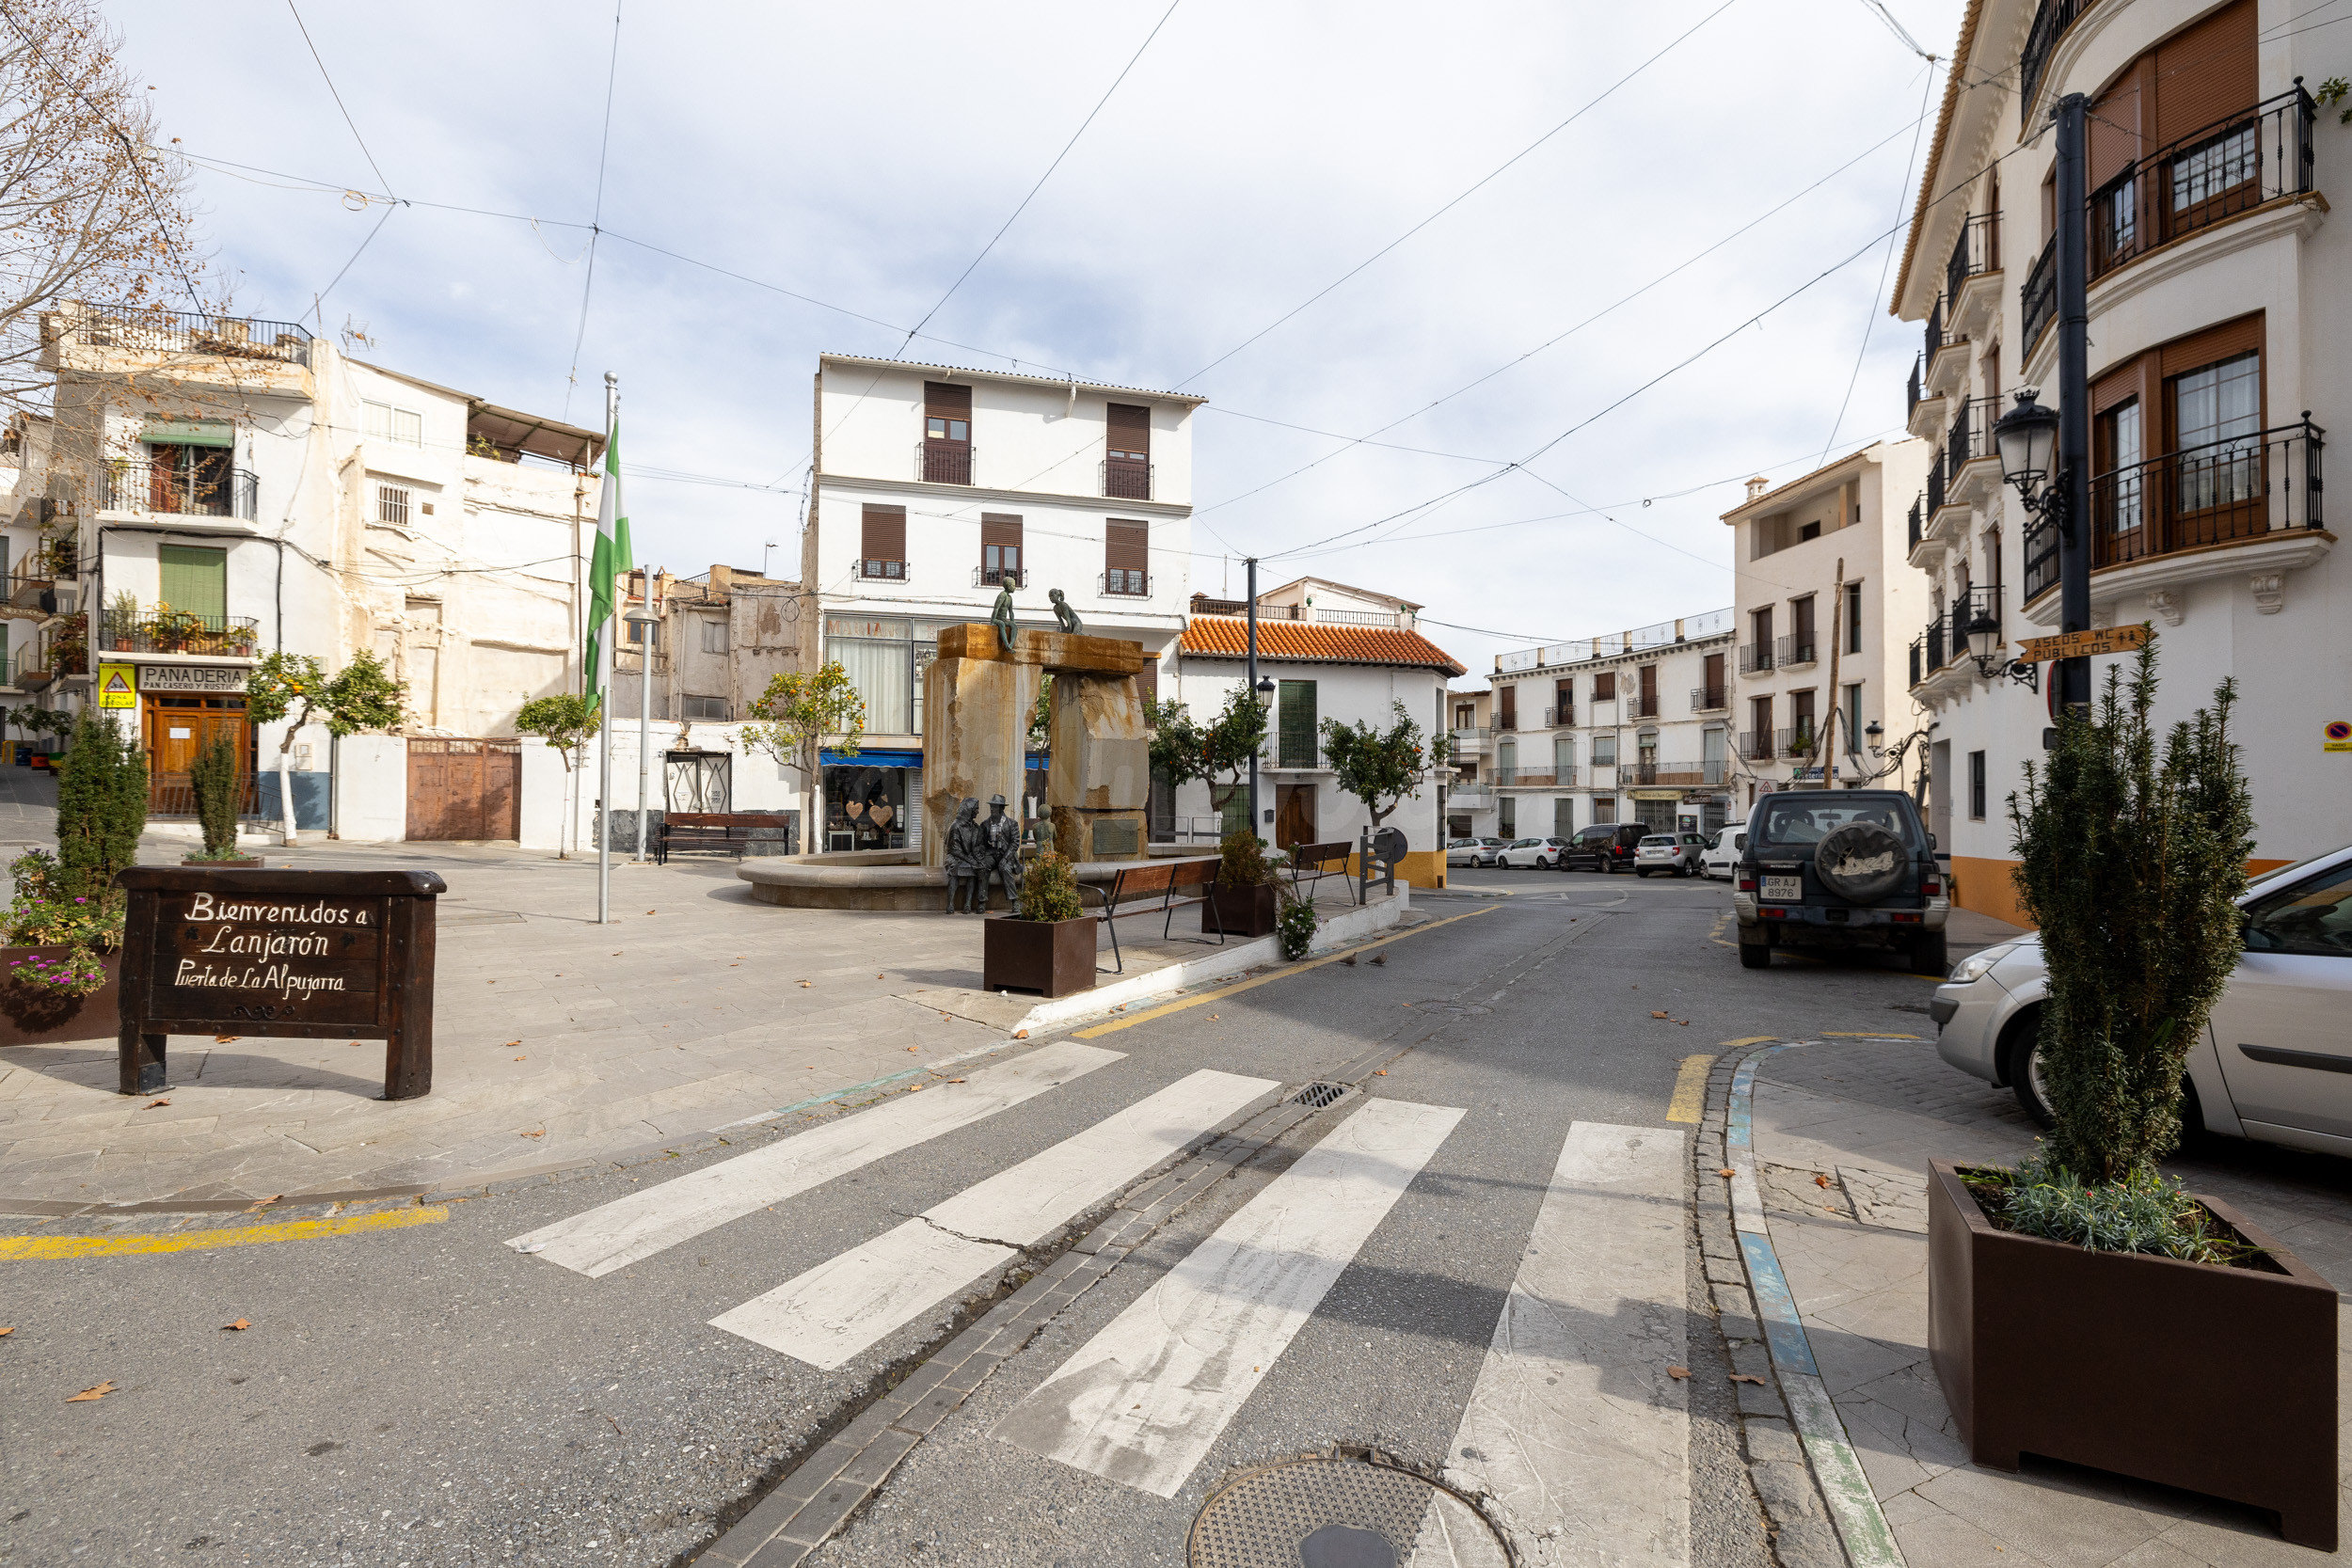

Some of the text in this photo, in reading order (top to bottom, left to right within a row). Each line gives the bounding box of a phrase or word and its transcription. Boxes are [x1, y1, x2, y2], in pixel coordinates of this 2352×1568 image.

[2034, 628, 2115, 649] ASEOS WC
[184, 892, 369, 925] Bienvenidos a
[1768, 889, 1794, 897] 8976
[200, 926, 329, 963] Lanjarón
[174, 958, 346, 1000] Puerta de La Alpujarra
